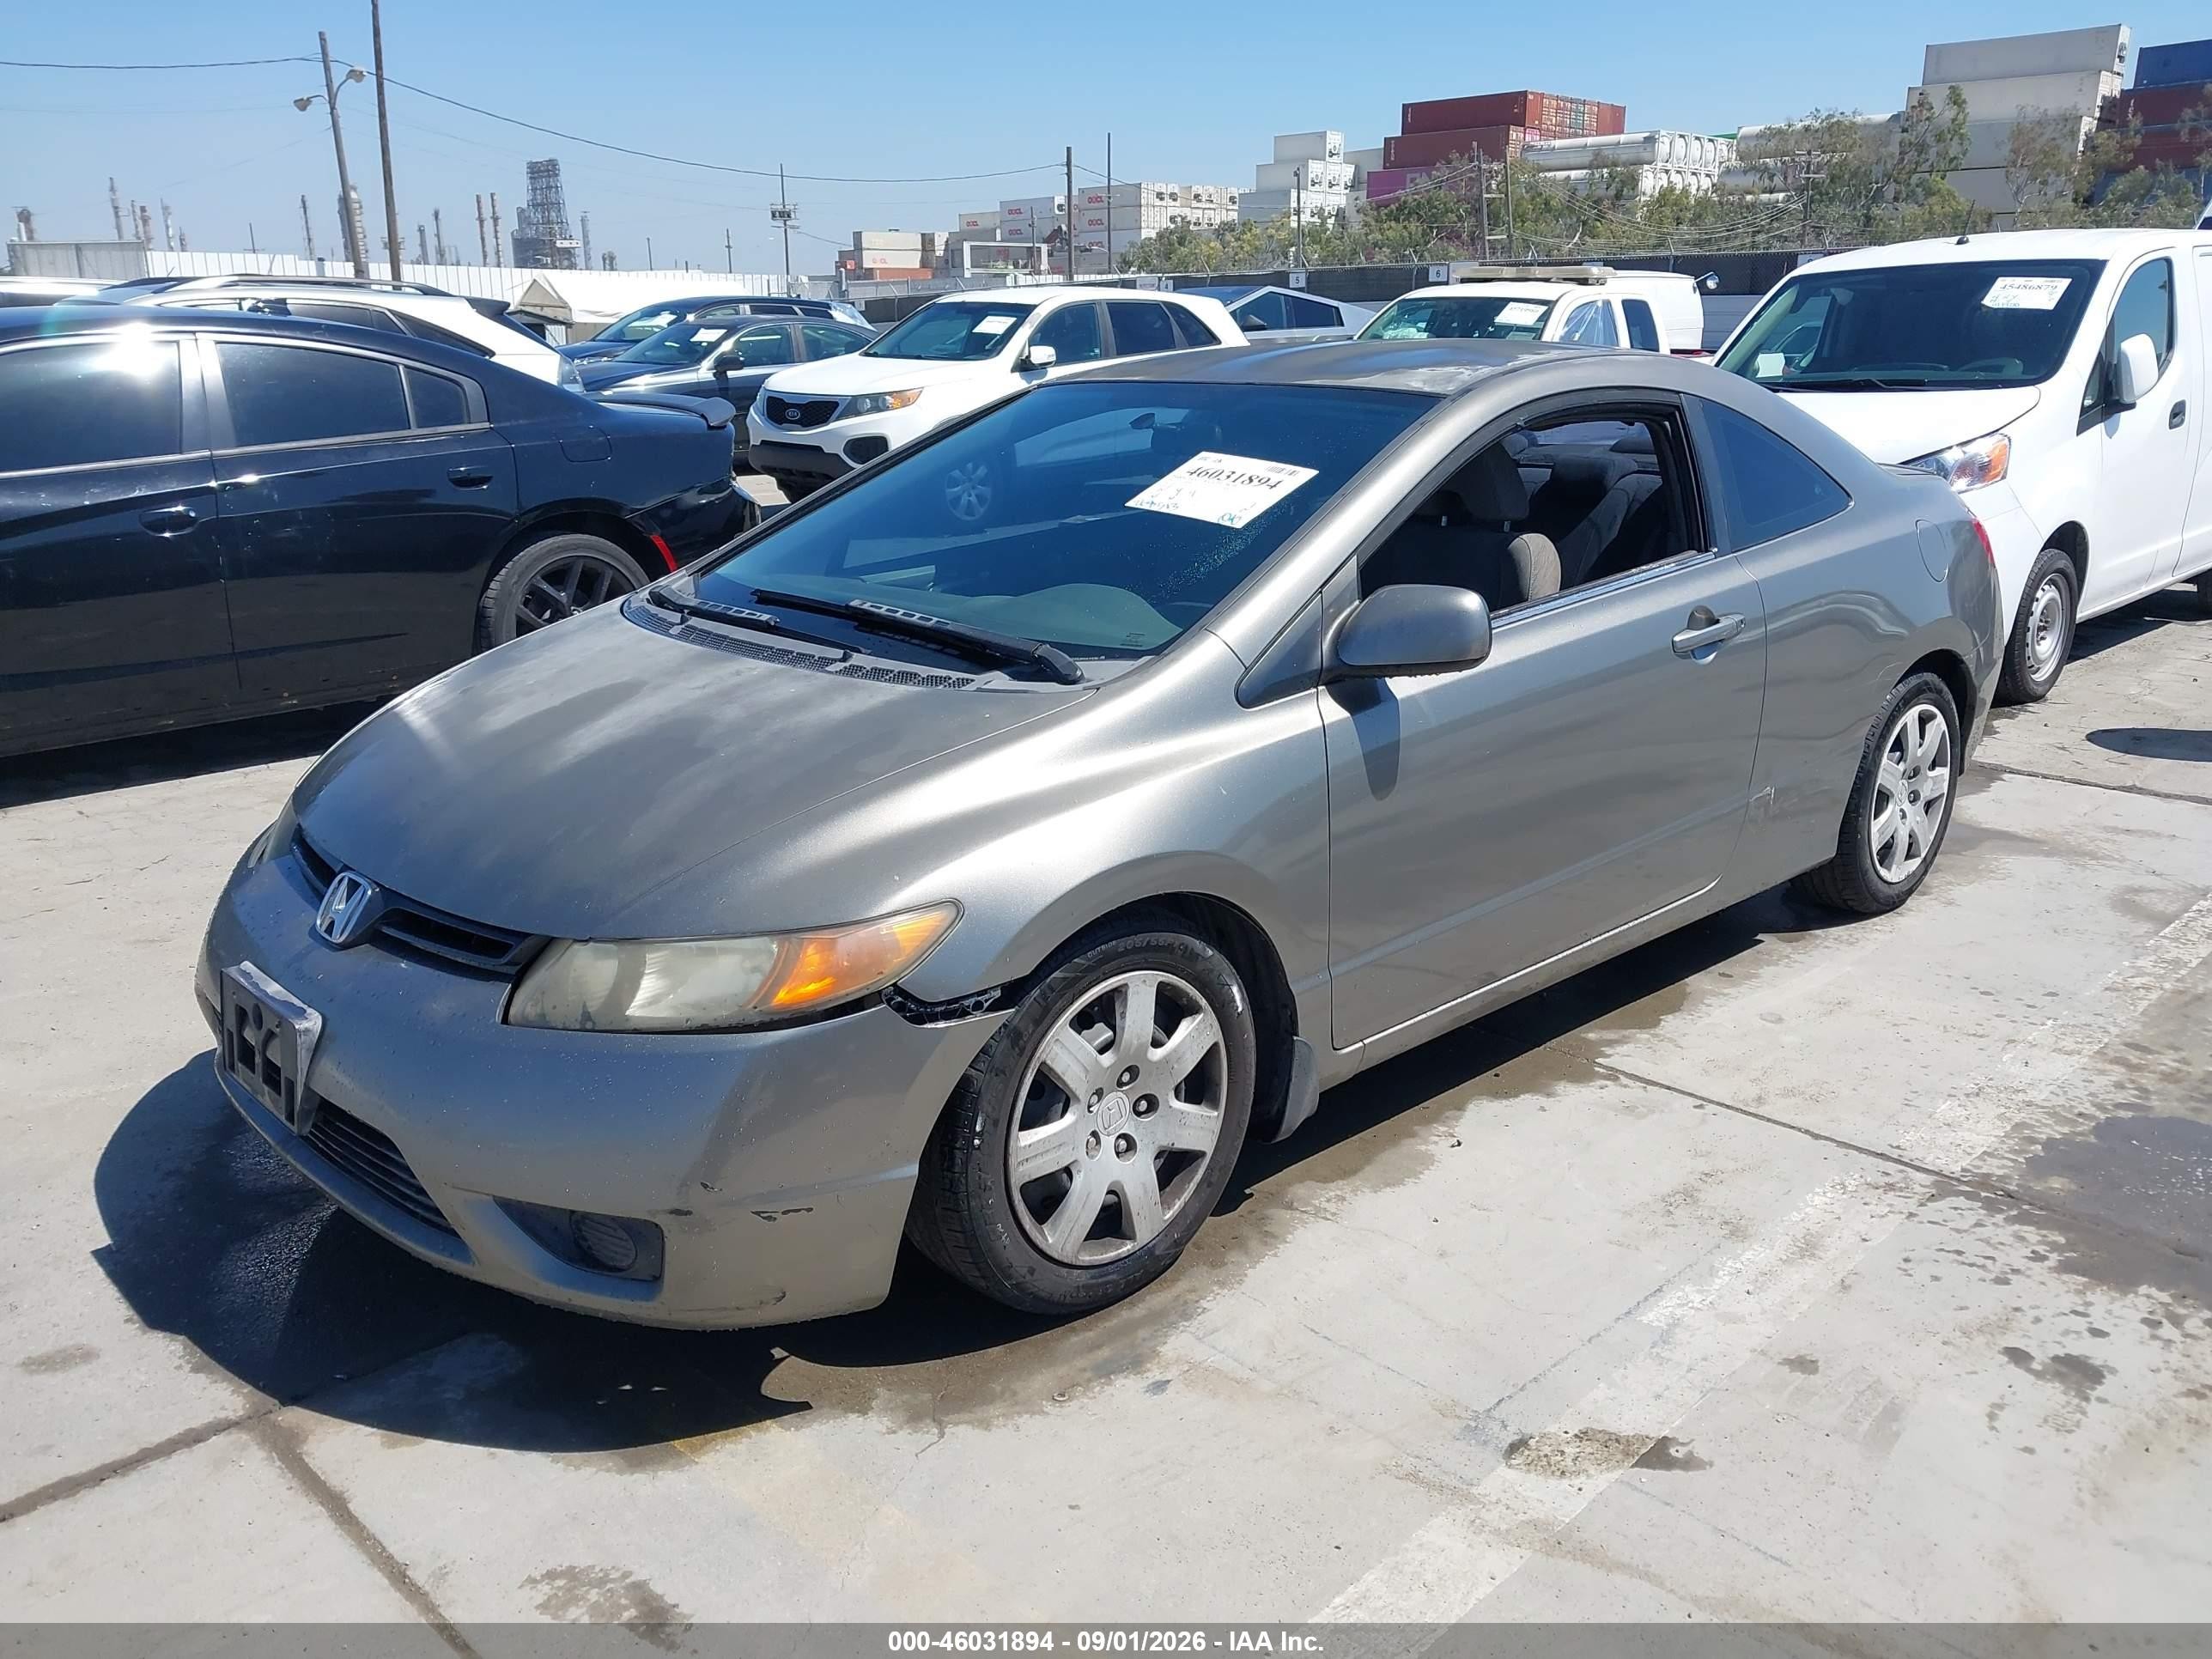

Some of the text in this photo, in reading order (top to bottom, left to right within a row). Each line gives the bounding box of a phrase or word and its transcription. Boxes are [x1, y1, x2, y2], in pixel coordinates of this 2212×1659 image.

[1087, 196, 1104, 204] OOCL
[1087, 218, 1104, 227] OOCL
[1435, 269, 1441, 278] 6
[1295, 276, 1300, 284] 5
[1186, 466, 1285, 490] 46031894
